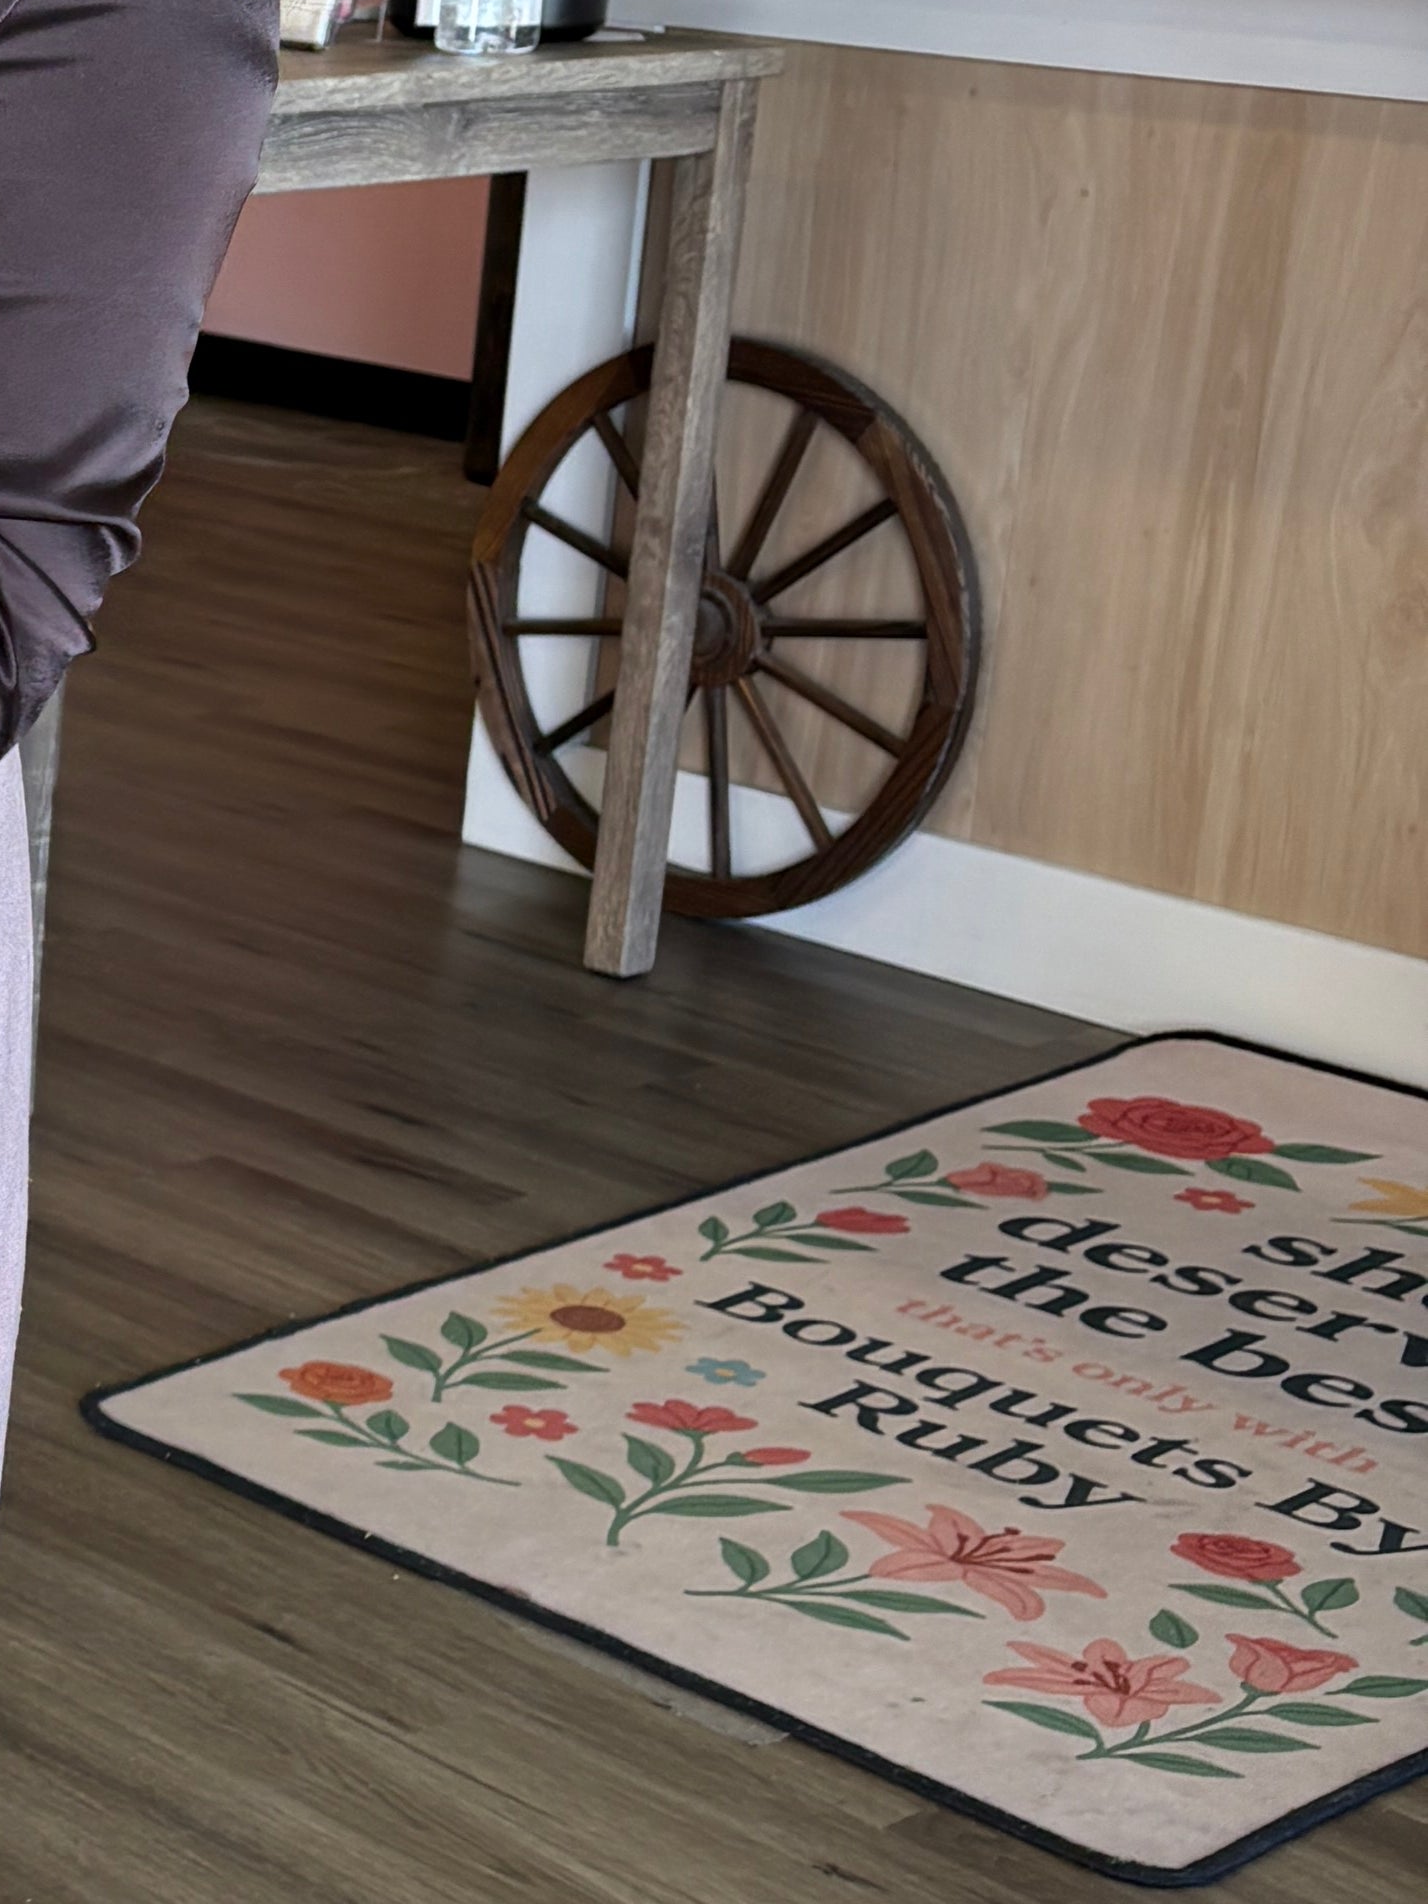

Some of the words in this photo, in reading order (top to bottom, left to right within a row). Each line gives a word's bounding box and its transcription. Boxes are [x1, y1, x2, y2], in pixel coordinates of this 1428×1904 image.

[940, 1253, 1167, 1339] the
[1242, 1235, 1428, 1310] sh
[694, 1280, 1253, 1490] Bouquets
[1254, 1478, 1428, 1556] By
[797, 1378, 1147, 1510] Ruby
[893, 1298, 1064, 1364] that's
[1071, 1360, 1219, 1415] only
[1232, 1412, 1380, 1475] with
